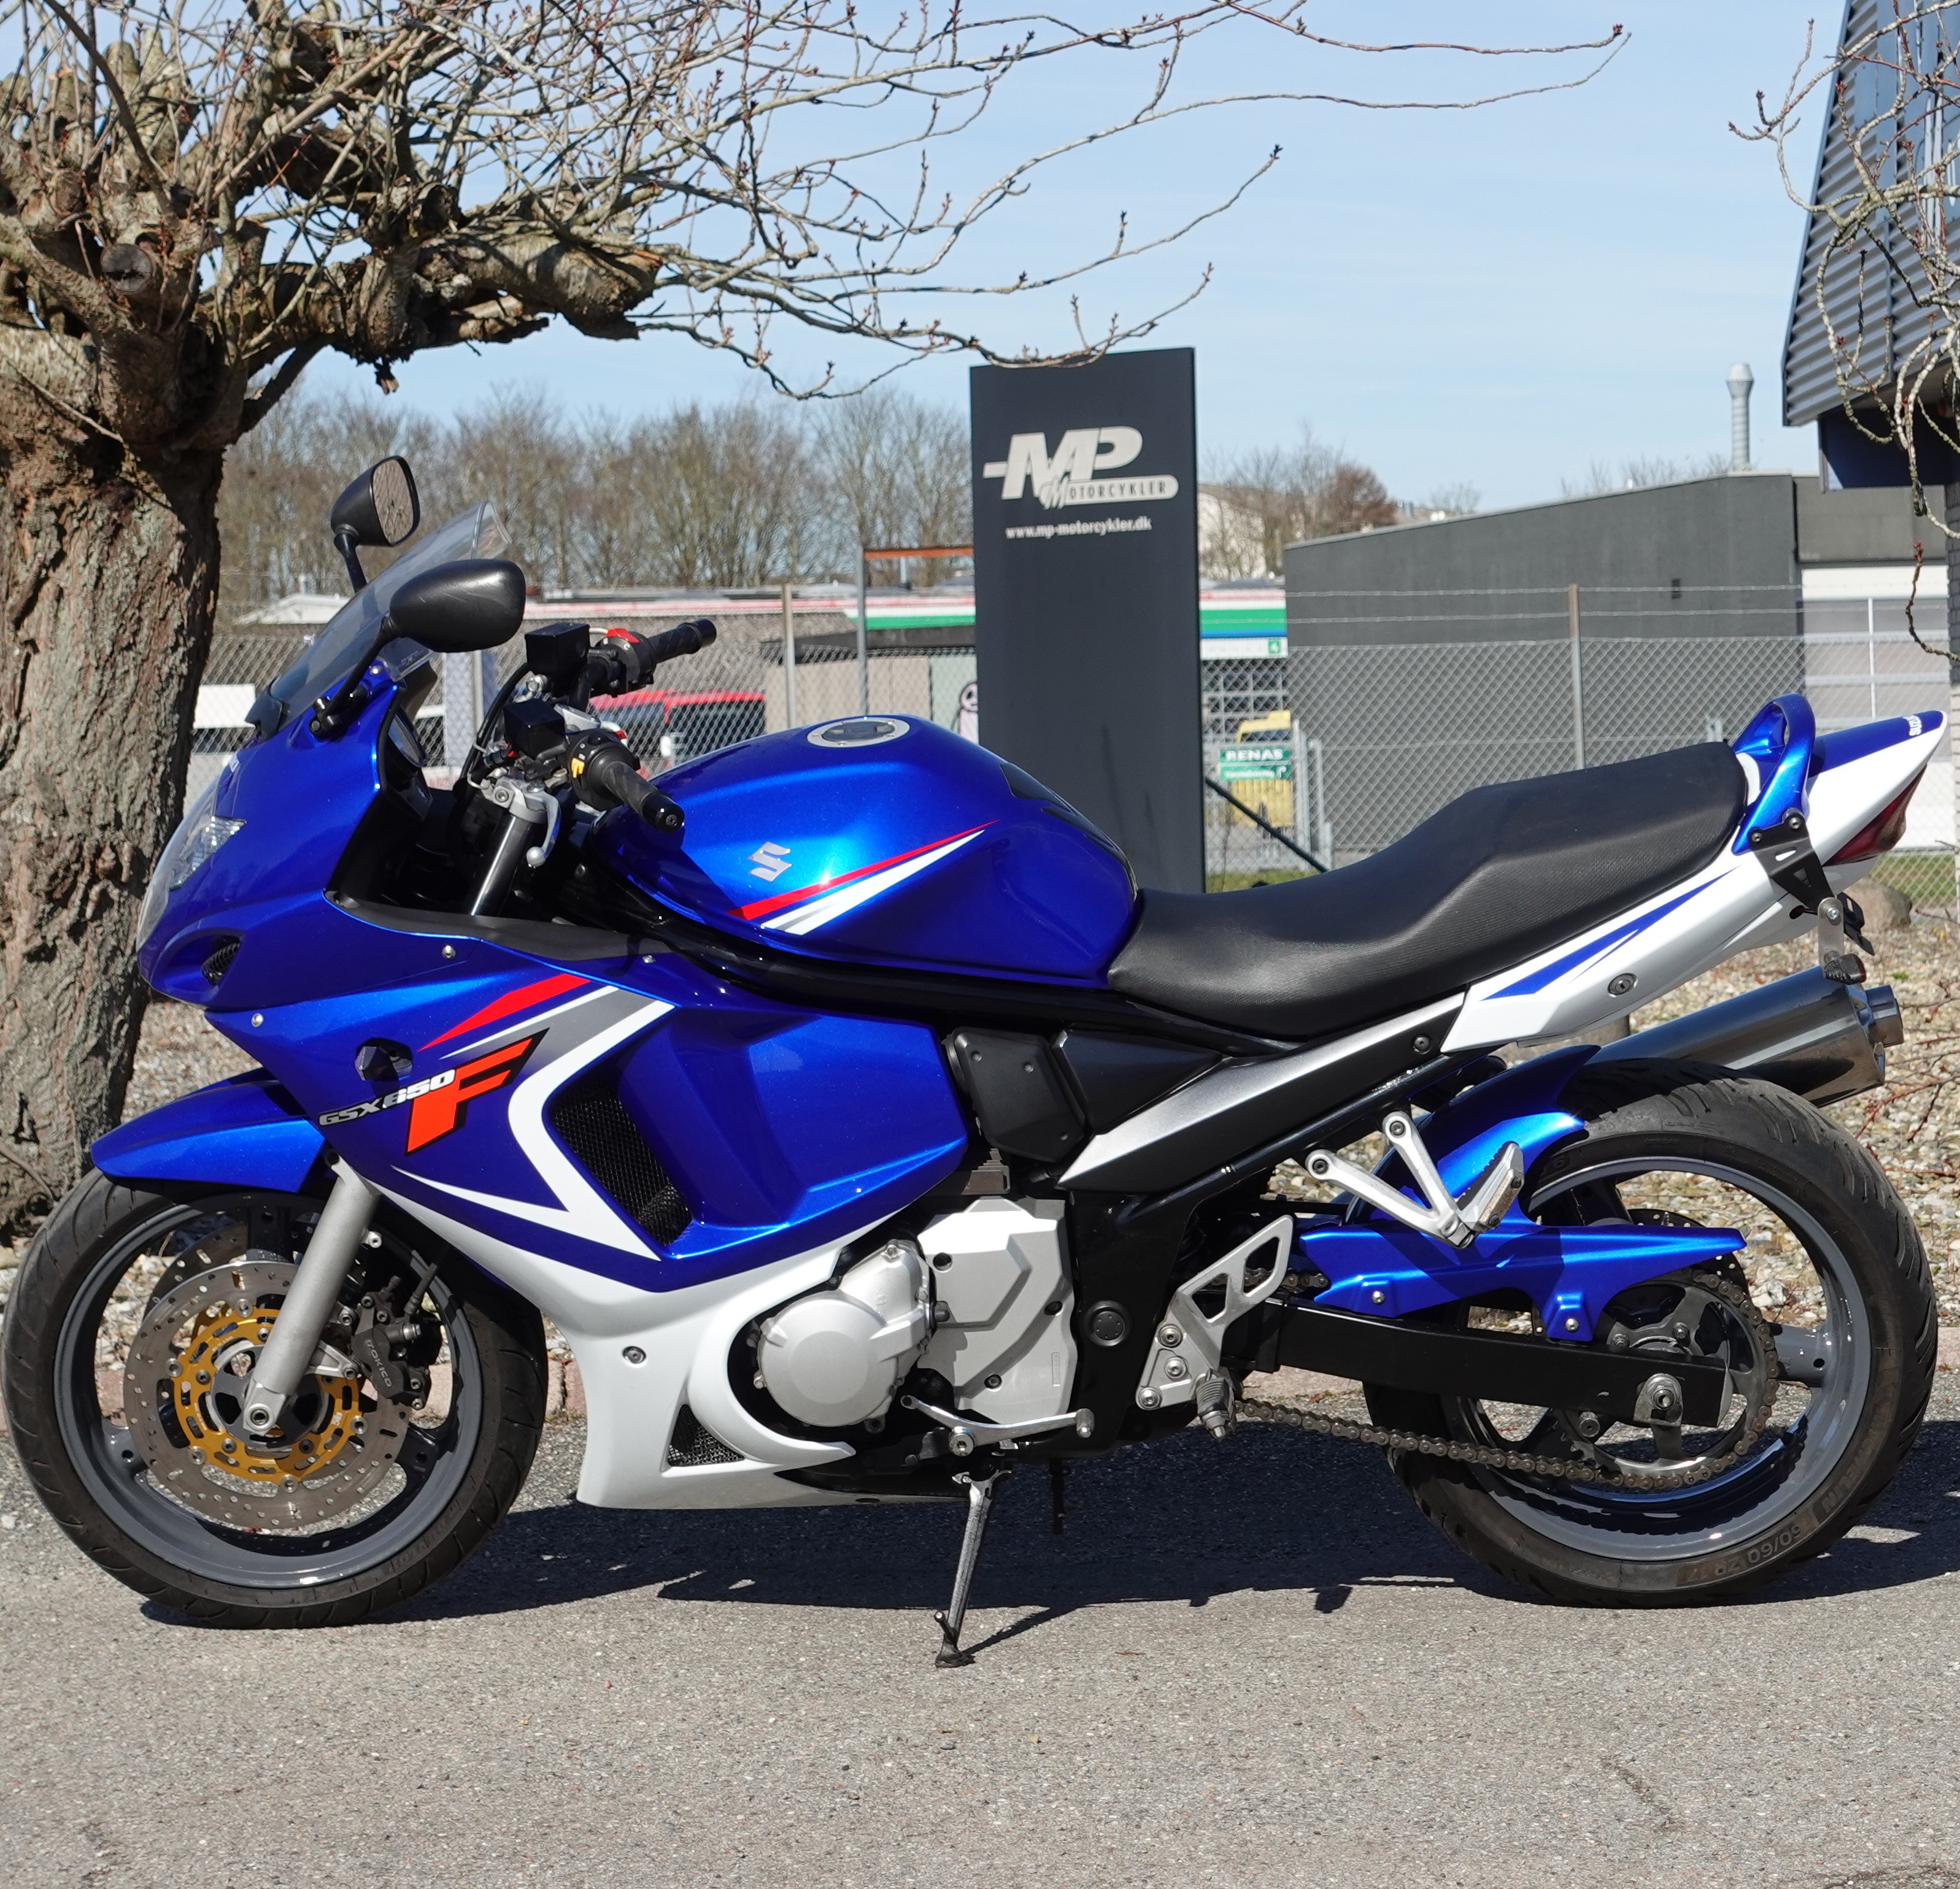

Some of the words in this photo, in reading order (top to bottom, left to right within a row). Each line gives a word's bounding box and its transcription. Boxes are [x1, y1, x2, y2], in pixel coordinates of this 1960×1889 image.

[1000, 426, 1143, 499] MP
[1040, 475, 1166, 509] MOTORCYKLER
[1005, 515, 1153, 539] www.mp-motorcykler.dk
[1225, 748, 1283, 761] RENAS
